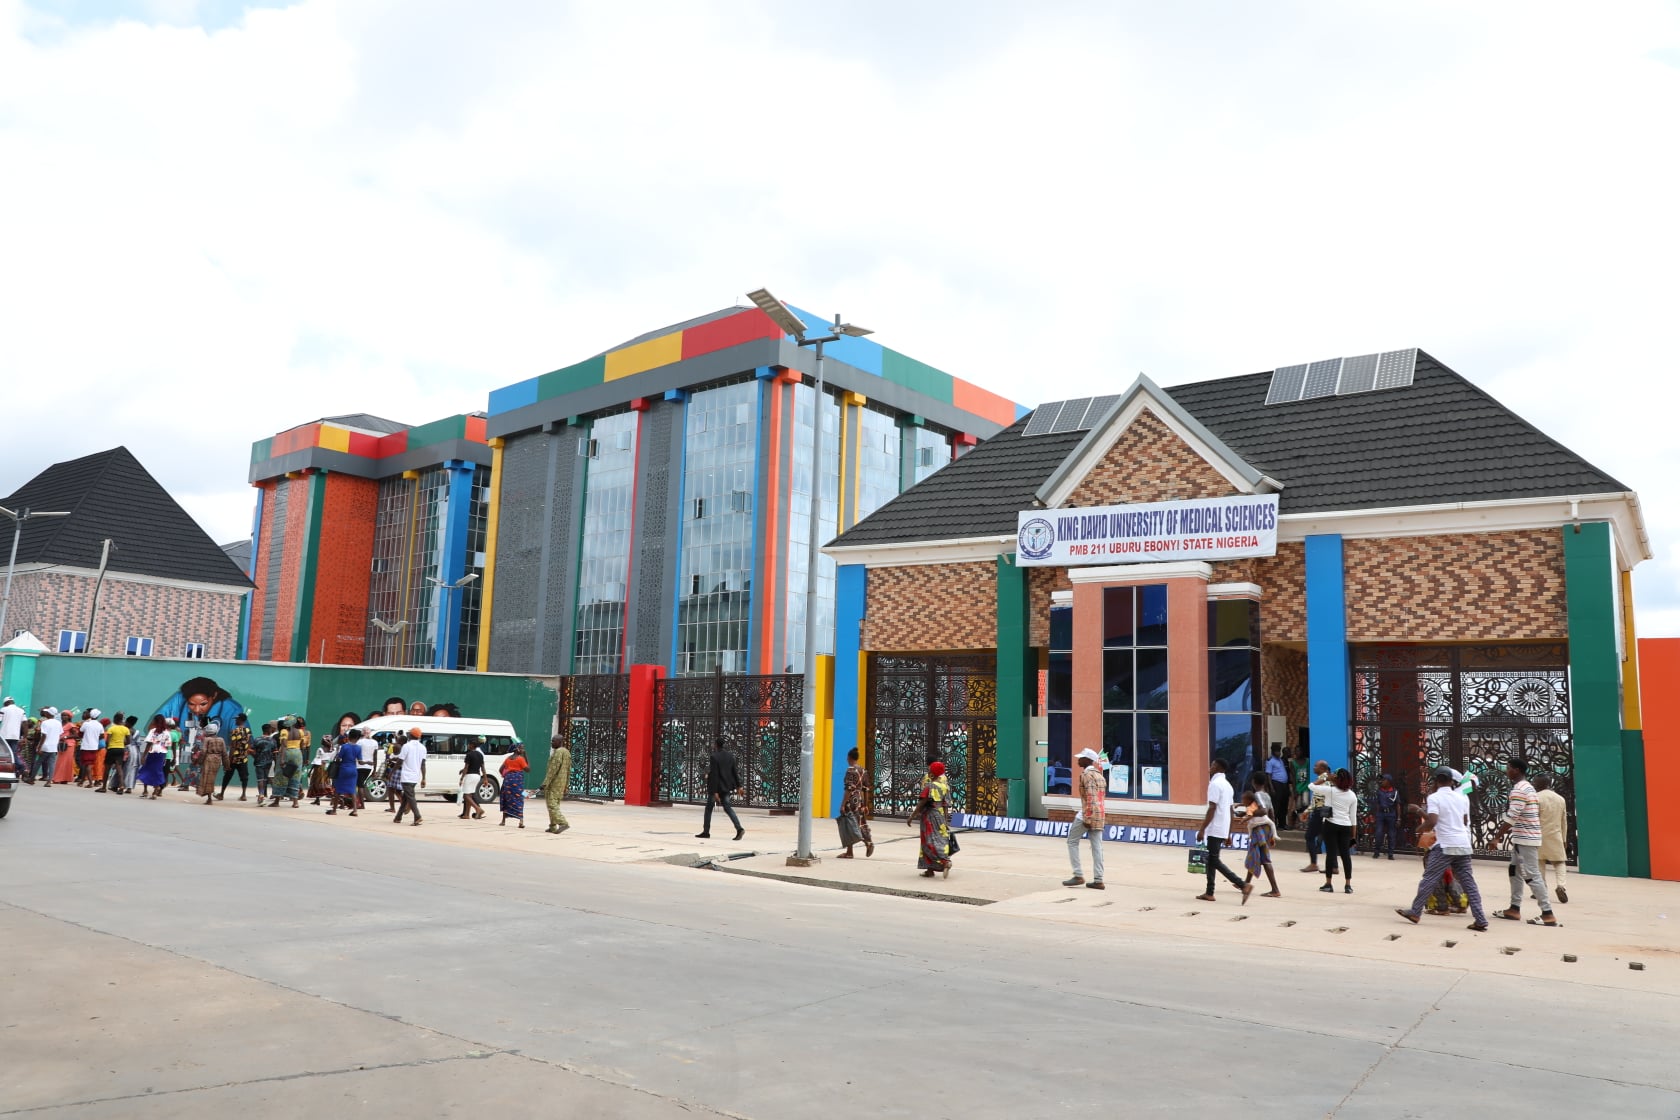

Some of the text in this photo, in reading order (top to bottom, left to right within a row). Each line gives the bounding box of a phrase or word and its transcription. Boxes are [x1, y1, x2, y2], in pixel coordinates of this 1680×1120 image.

[1057, 516, 1079, 541] KING
[1080, 514, 1108, 540] DAVID
[1109, 510, 1165, 538] UNIVERSITY
[1166, 509, 1178, 535] OF
[1180, 506, 1223, 534] MEDICAL
[1225, 503, 1275, 532] SCIENCES
[1069, 535, 1259, 556] PMB 211 UBURU EBONYI STATE NIGERIA
[962, 814, 989, 829] KING
[994, 816, 1027, 833] DAVID
[1109, 825, 1125, 841] OF
[1129, 827, 1186, 845] MEDICAL
